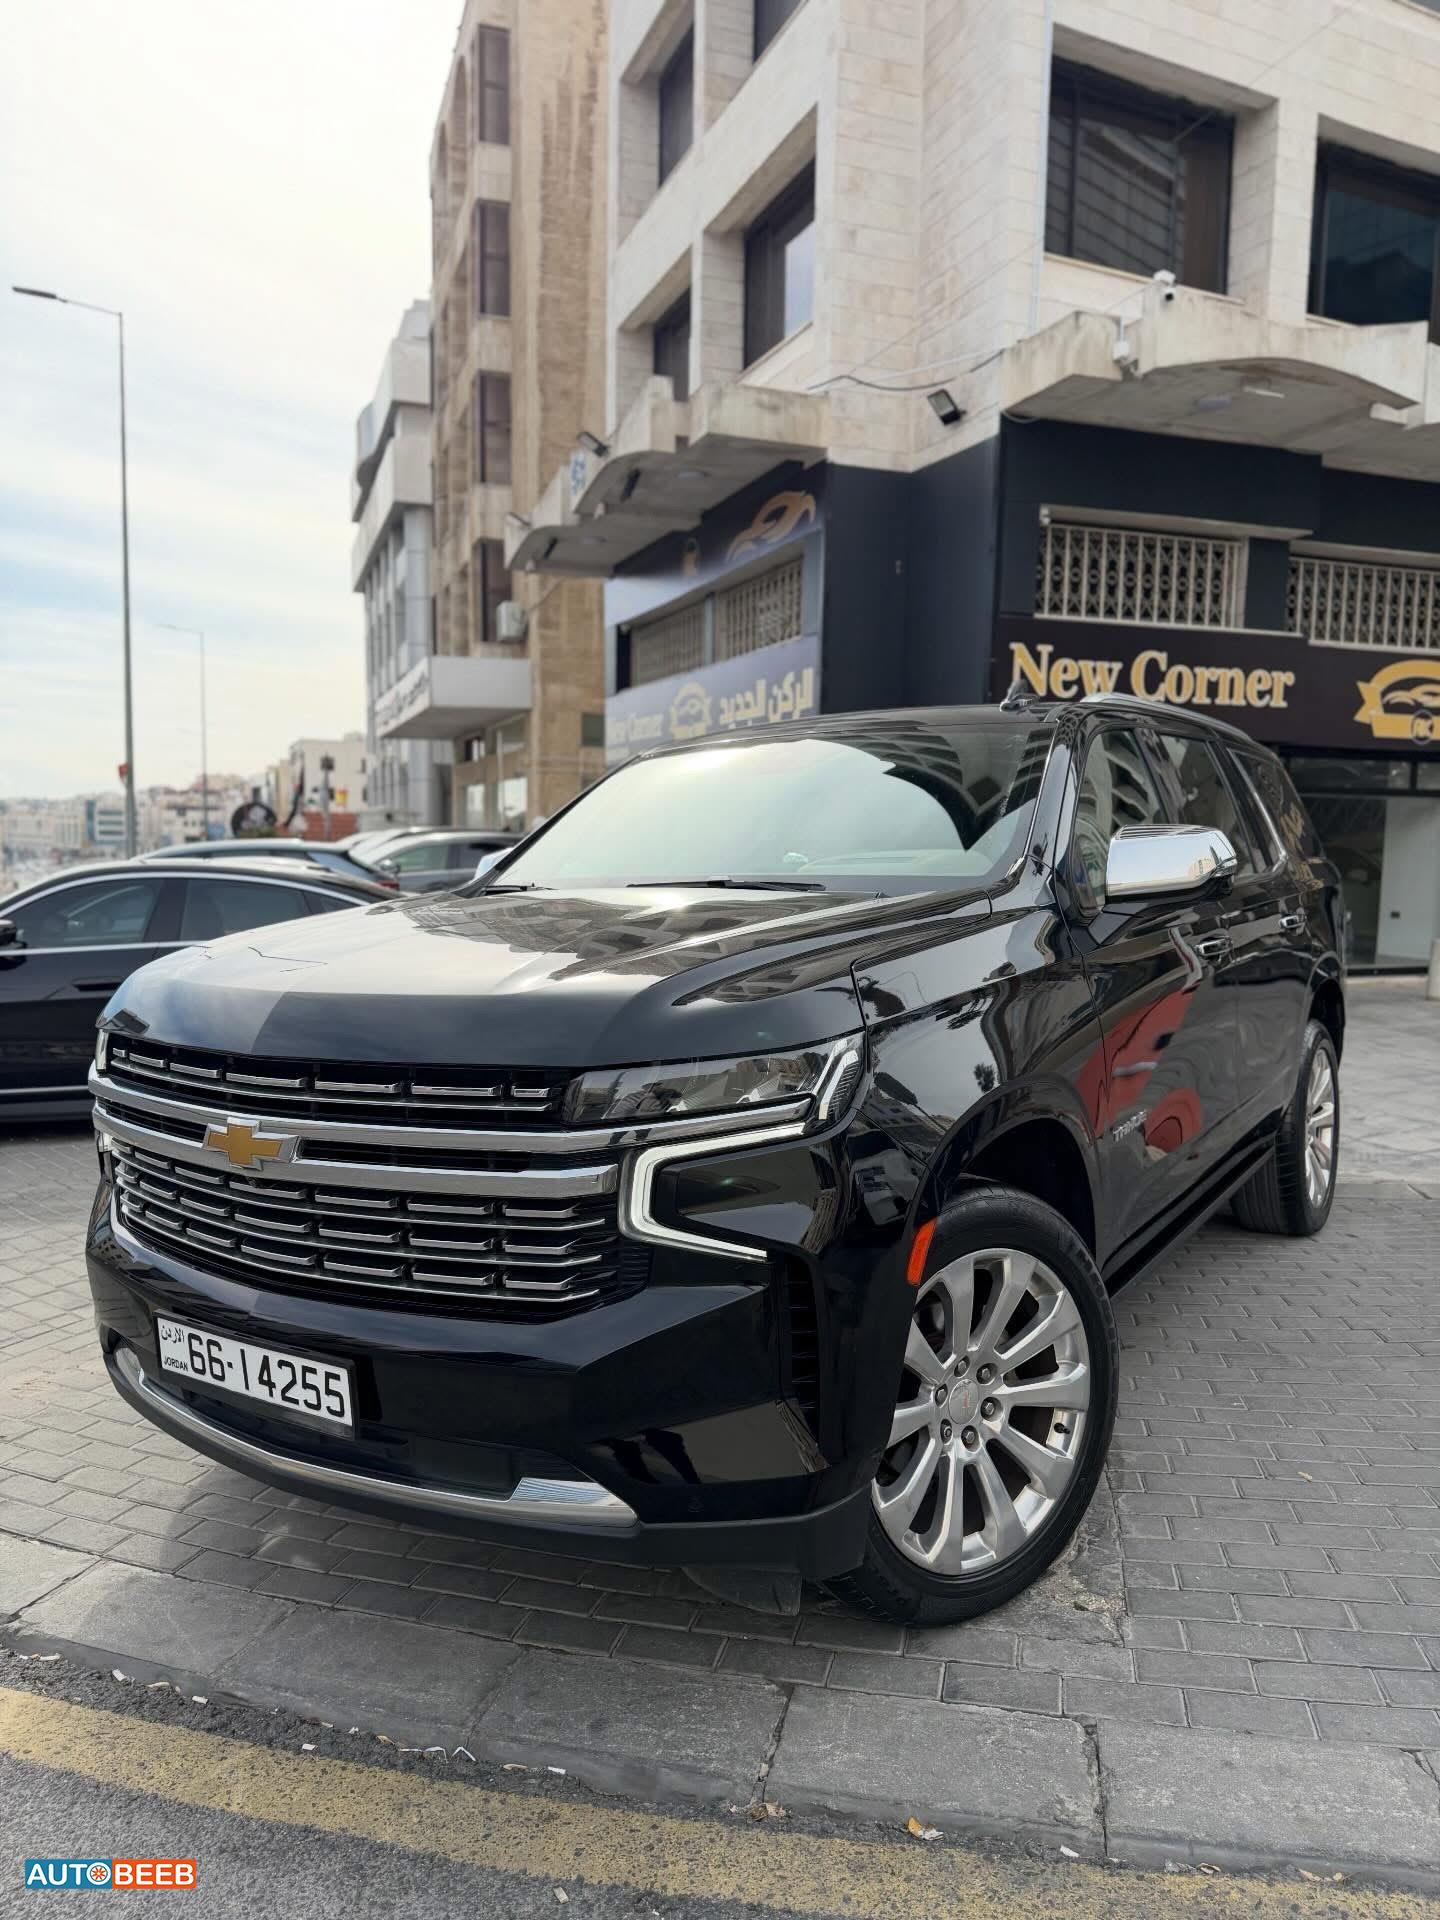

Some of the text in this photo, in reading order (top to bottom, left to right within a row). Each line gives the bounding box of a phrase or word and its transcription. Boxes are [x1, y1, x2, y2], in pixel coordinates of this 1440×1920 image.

[1009, 642, 1295, 708] New Corner
[163, 1356, 189, 1371] JORDAN
